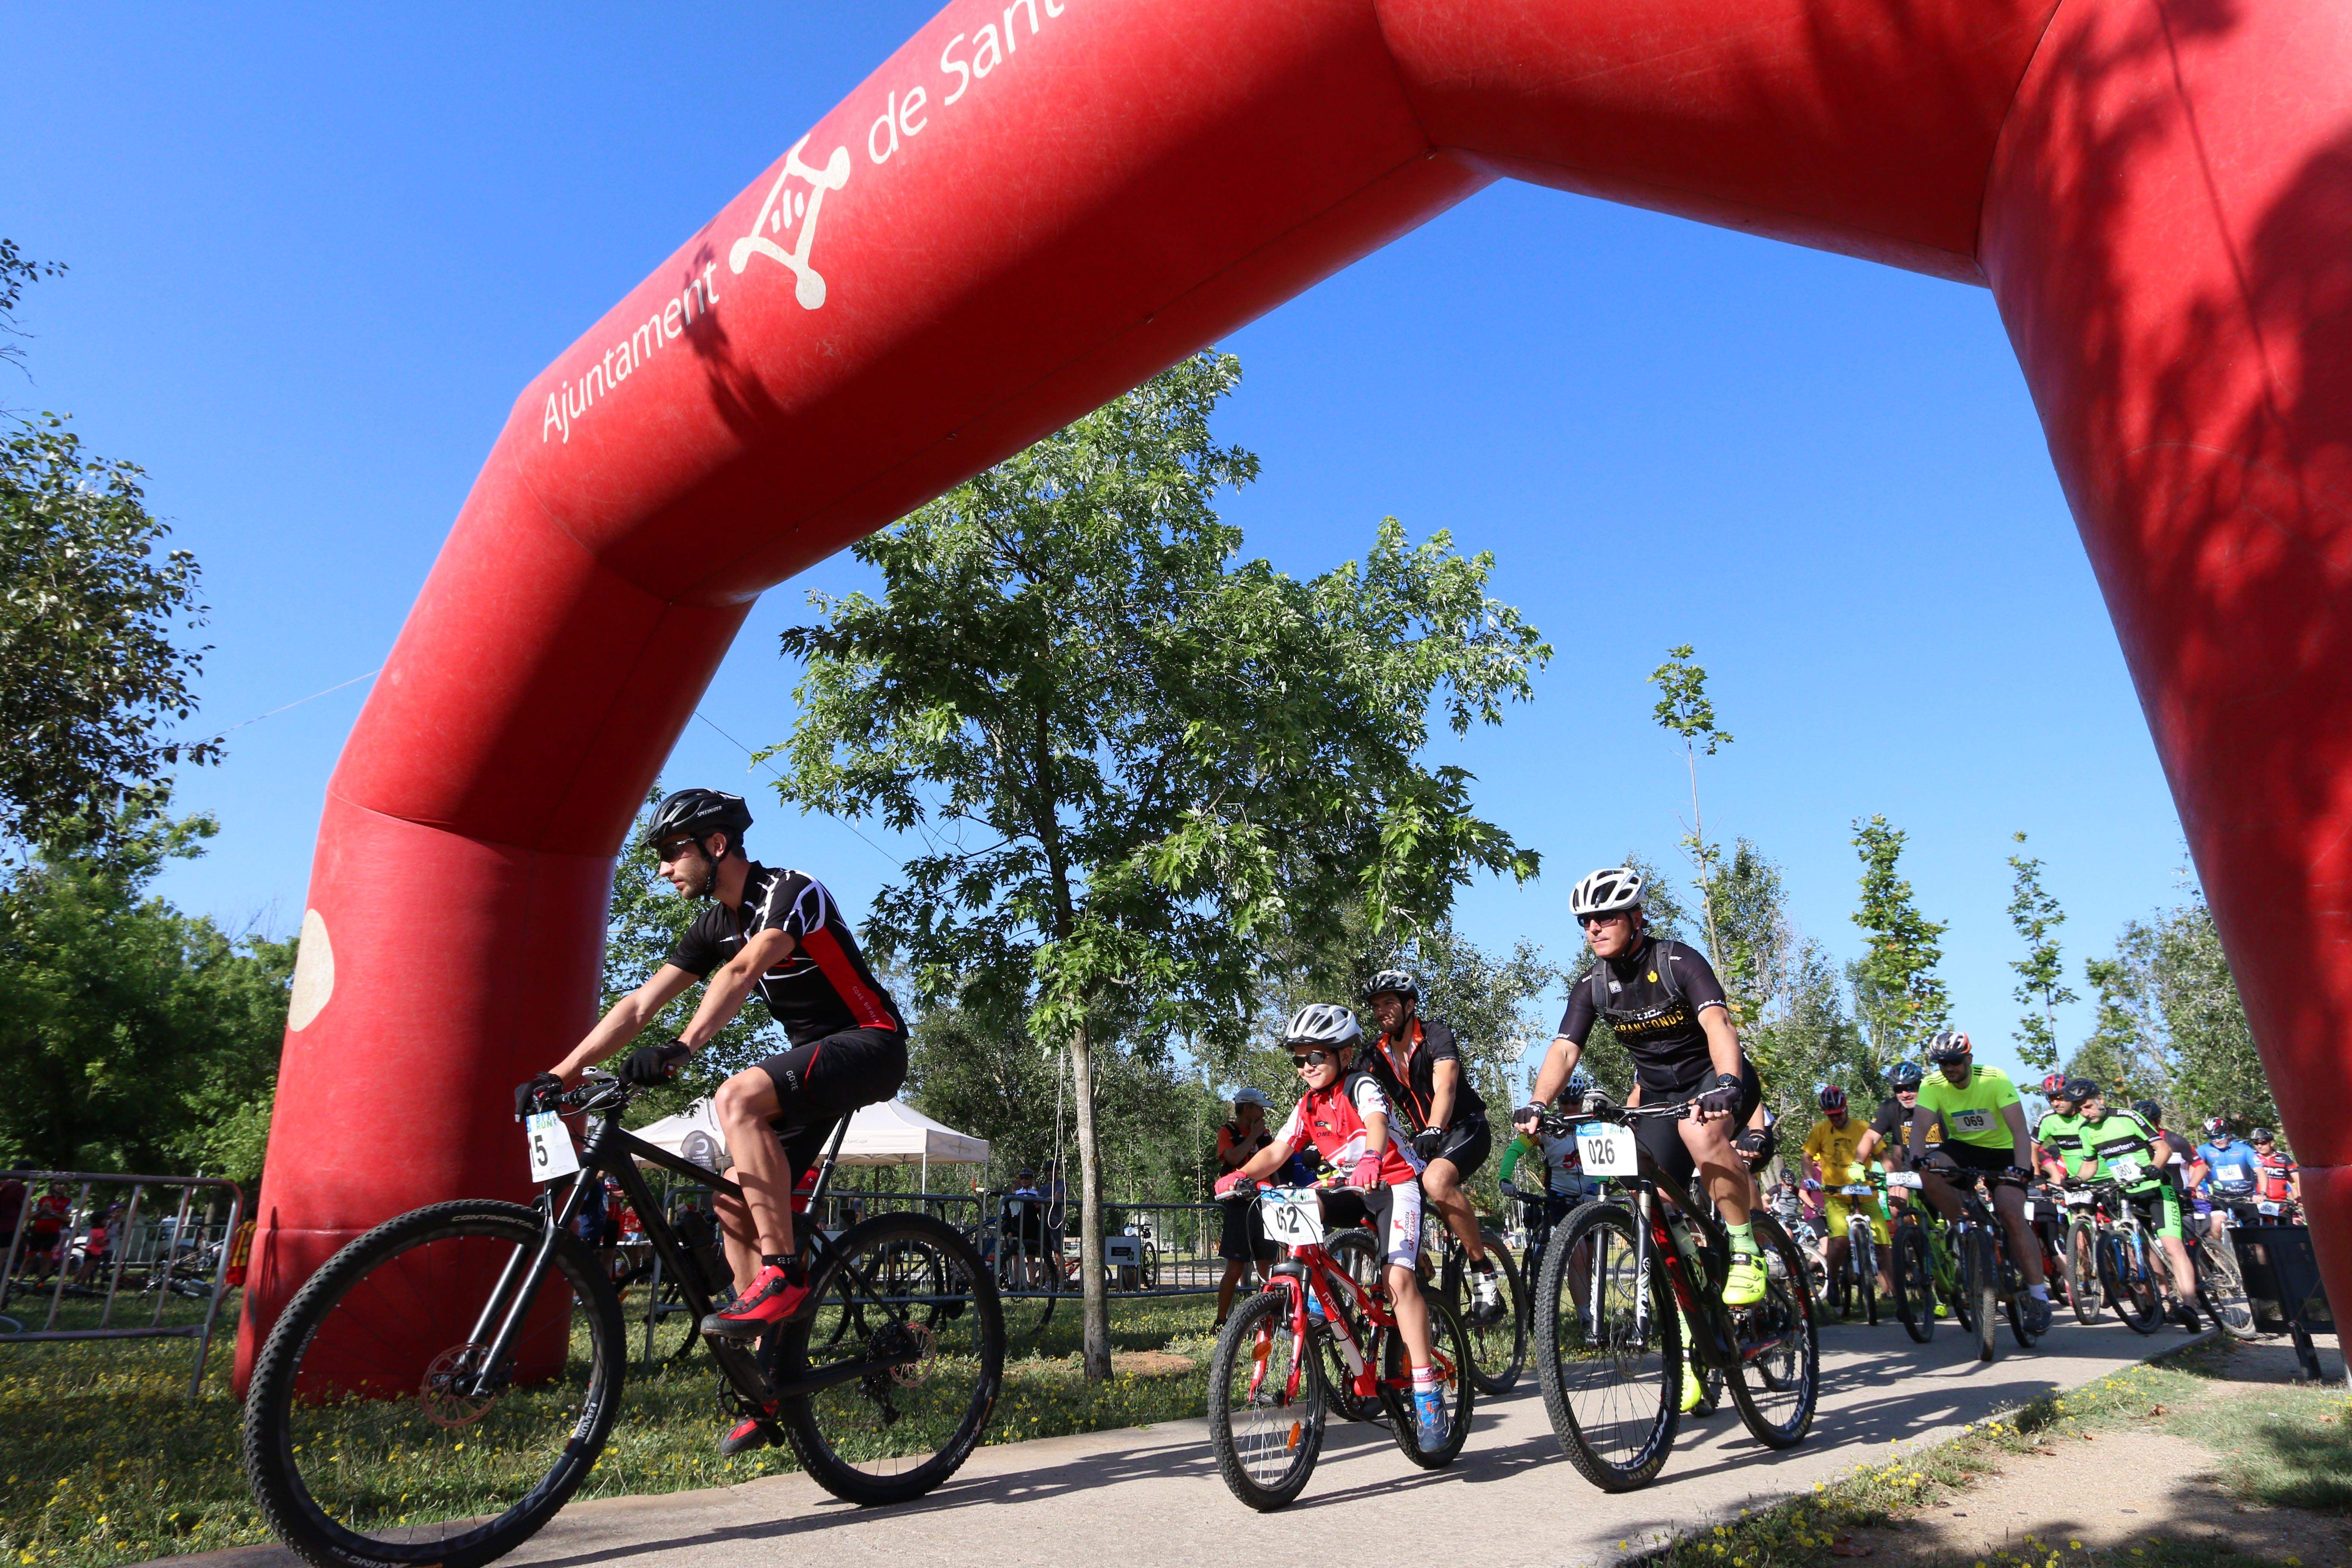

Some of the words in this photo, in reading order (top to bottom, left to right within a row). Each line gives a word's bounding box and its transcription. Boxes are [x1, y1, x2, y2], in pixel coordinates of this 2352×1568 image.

[543, 260, 720, 444] Ajuntament
[868, 86, 928, 164] de
[697, 805, 722, 817] SPECIALIZED
[786, 1070, 798, 1091] GORE
[1963, 1115, 1984, 1127] 069
[2116, 1109, 2146, 1127] EUSKADI
[1588, 1139, 1615, 1165] 026
[1896, 1173, 1913, 1182] 068
[2260, 1203, 2272, 1213] 060
[451, 1214, 536, 1230] CONTINENTAL
